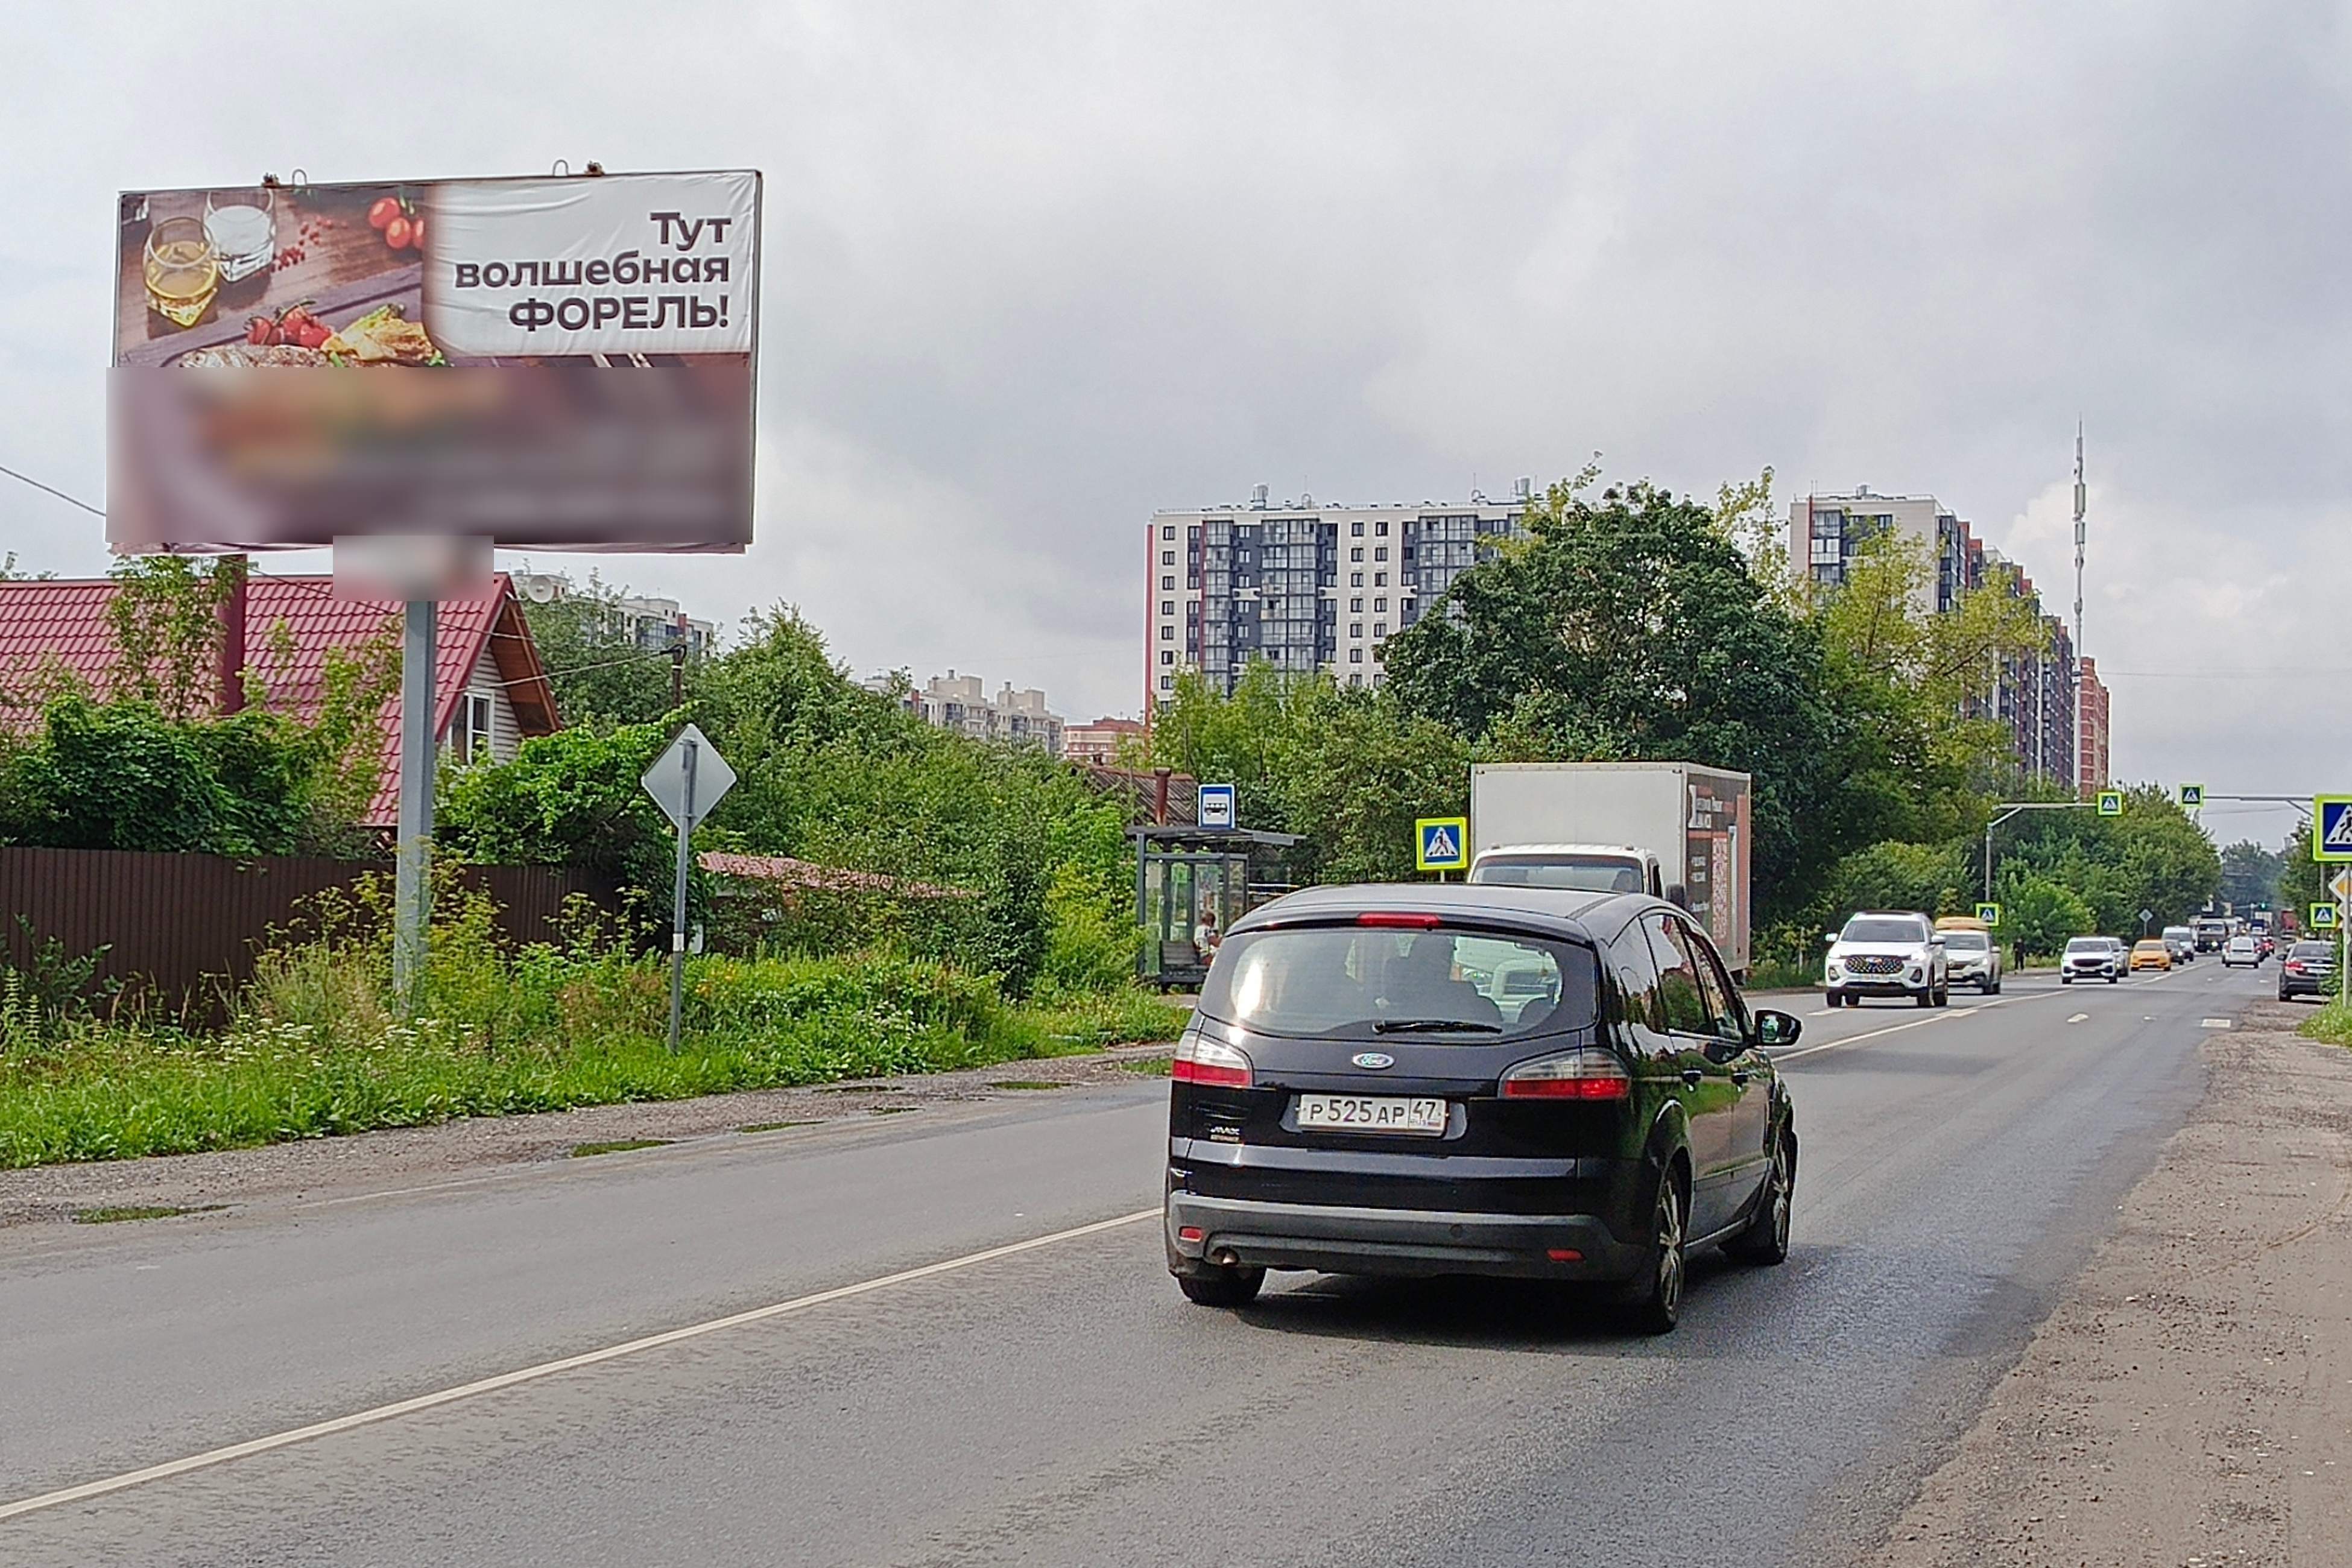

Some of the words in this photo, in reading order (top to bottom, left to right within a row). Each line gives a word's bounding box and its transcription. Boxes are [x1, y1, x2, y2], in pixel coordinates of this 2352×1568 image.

[650, 212, 732, 251] Тут
[455, 250, 729, 288] волшебная
[508, 294, 729, 332] ФОРЕЛЬ!
